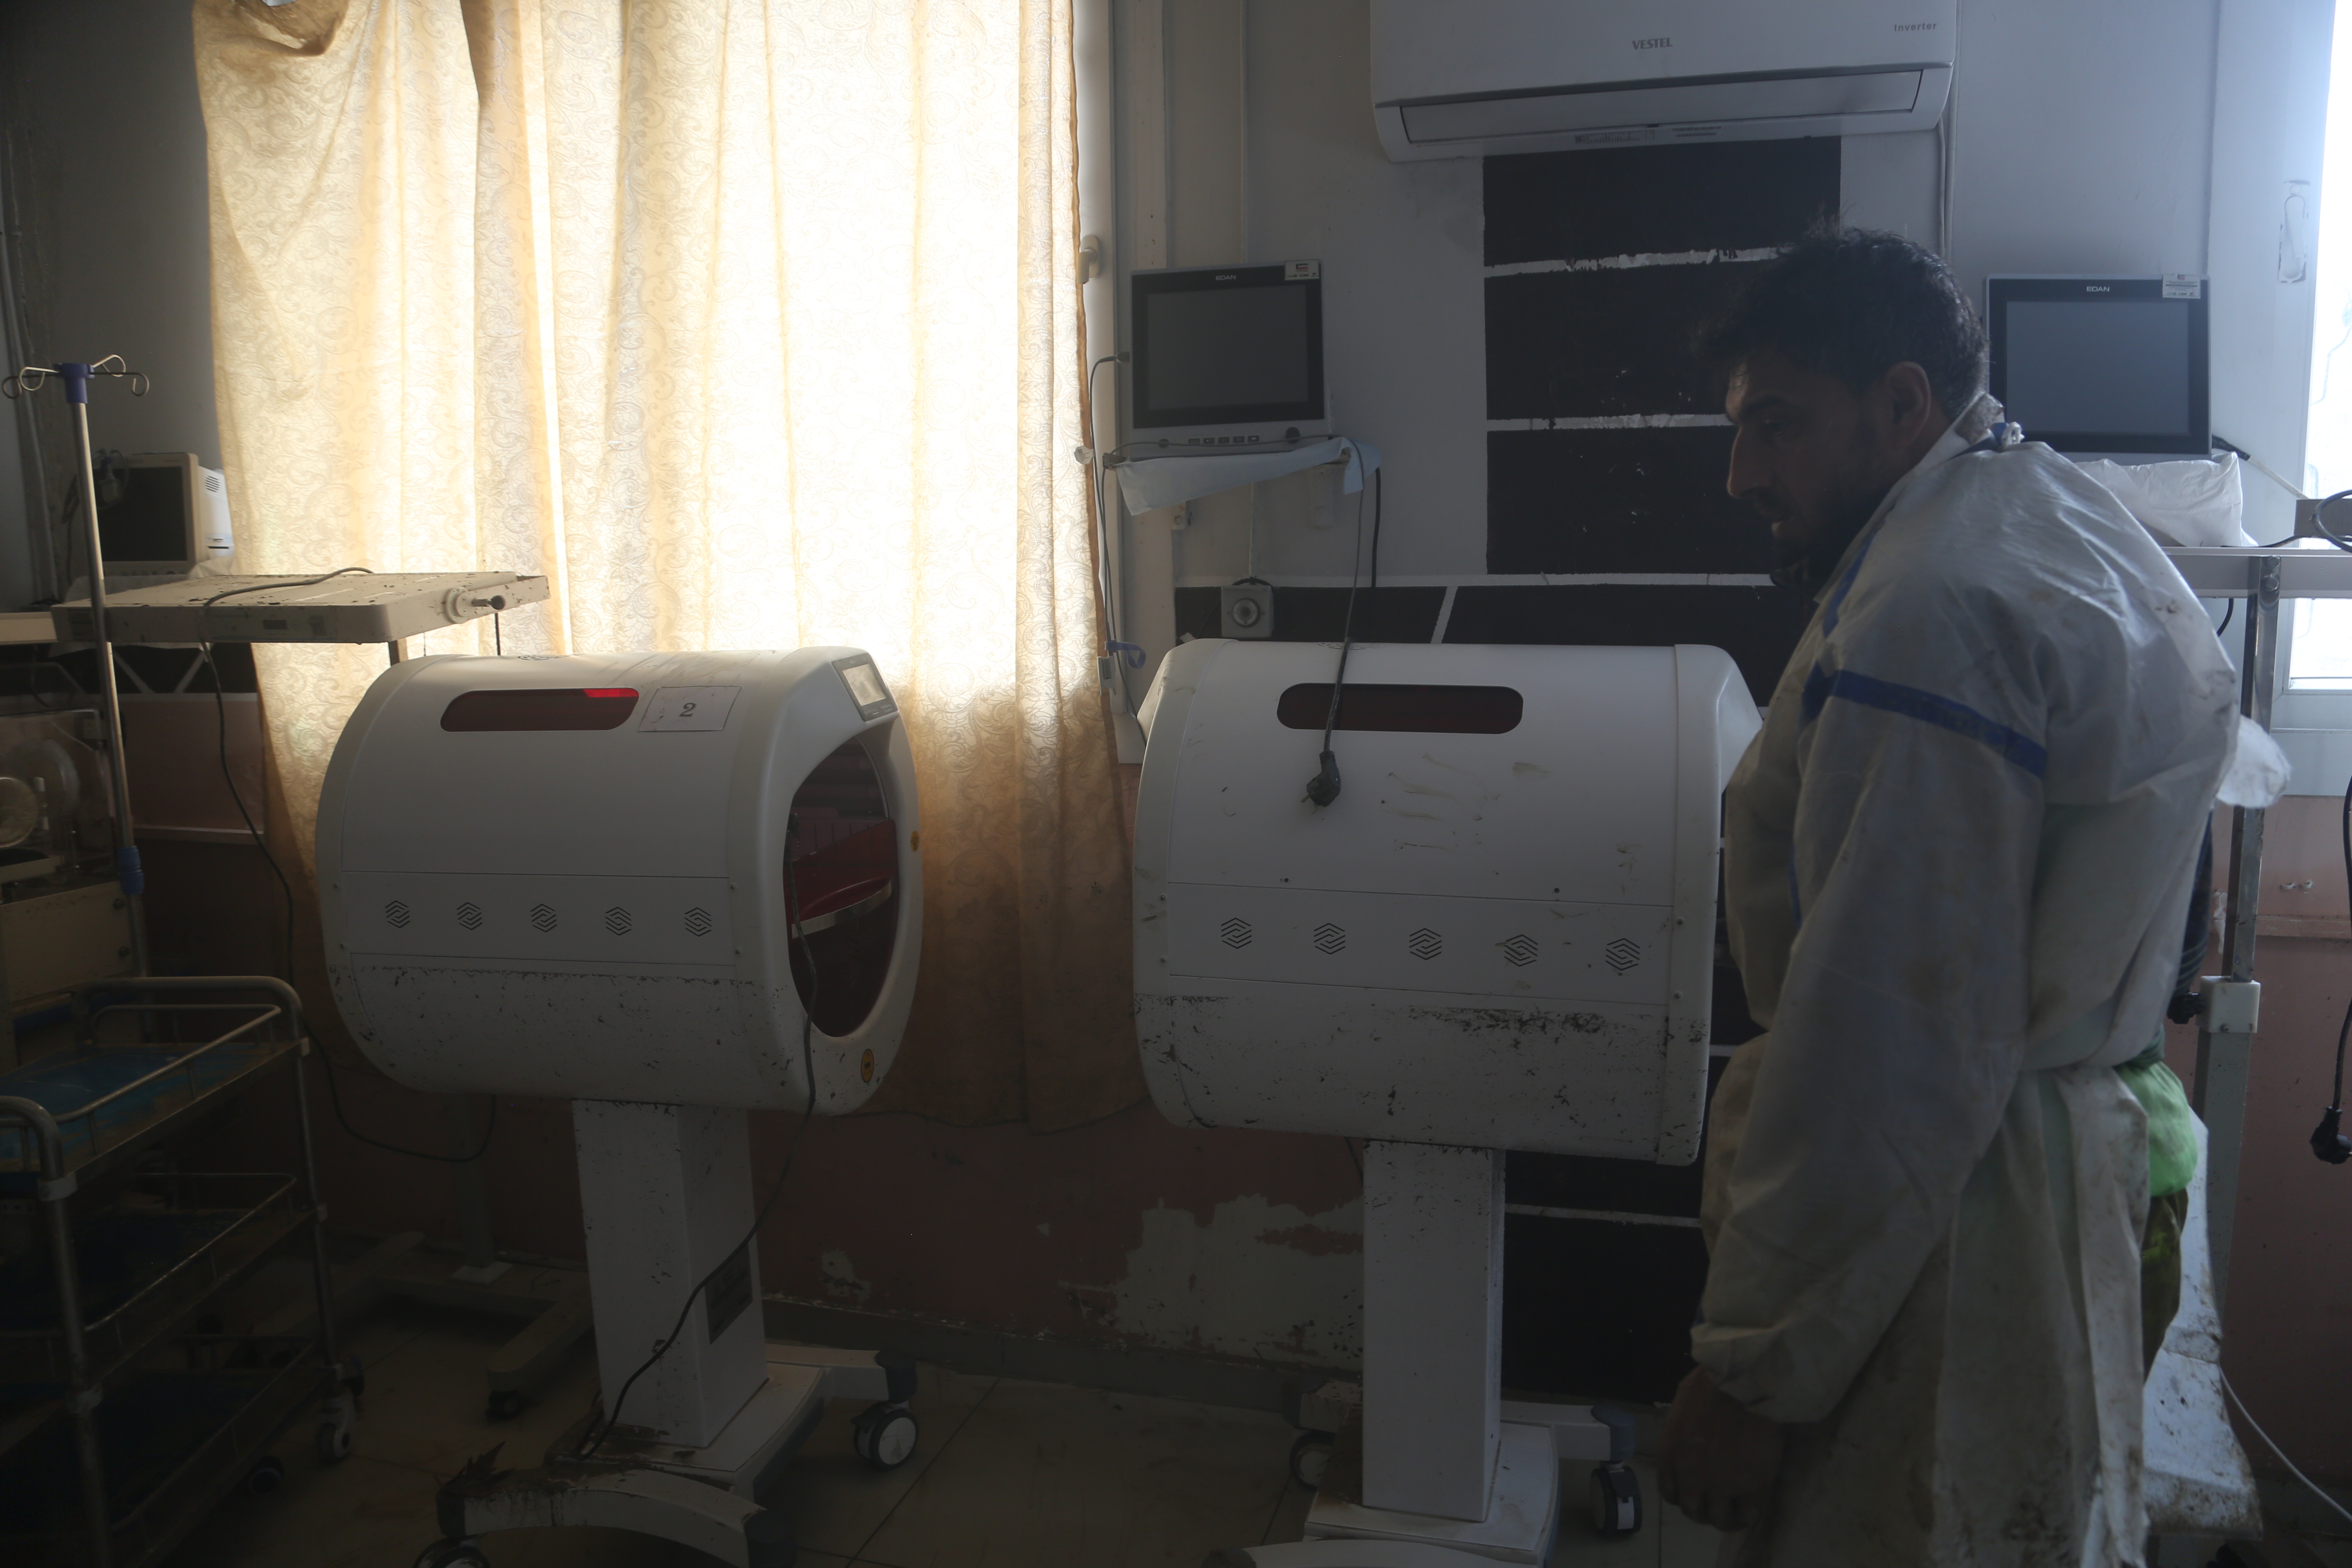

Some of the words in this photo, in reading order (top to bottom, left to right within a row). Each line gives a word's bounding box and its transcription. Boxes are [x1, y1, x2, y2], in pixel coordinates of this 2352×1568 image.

[1895, 22, 1937, 31] Inverter
[1632, 38, 1673, 50] VESTEL
[679, 702, 697, 718] 2
